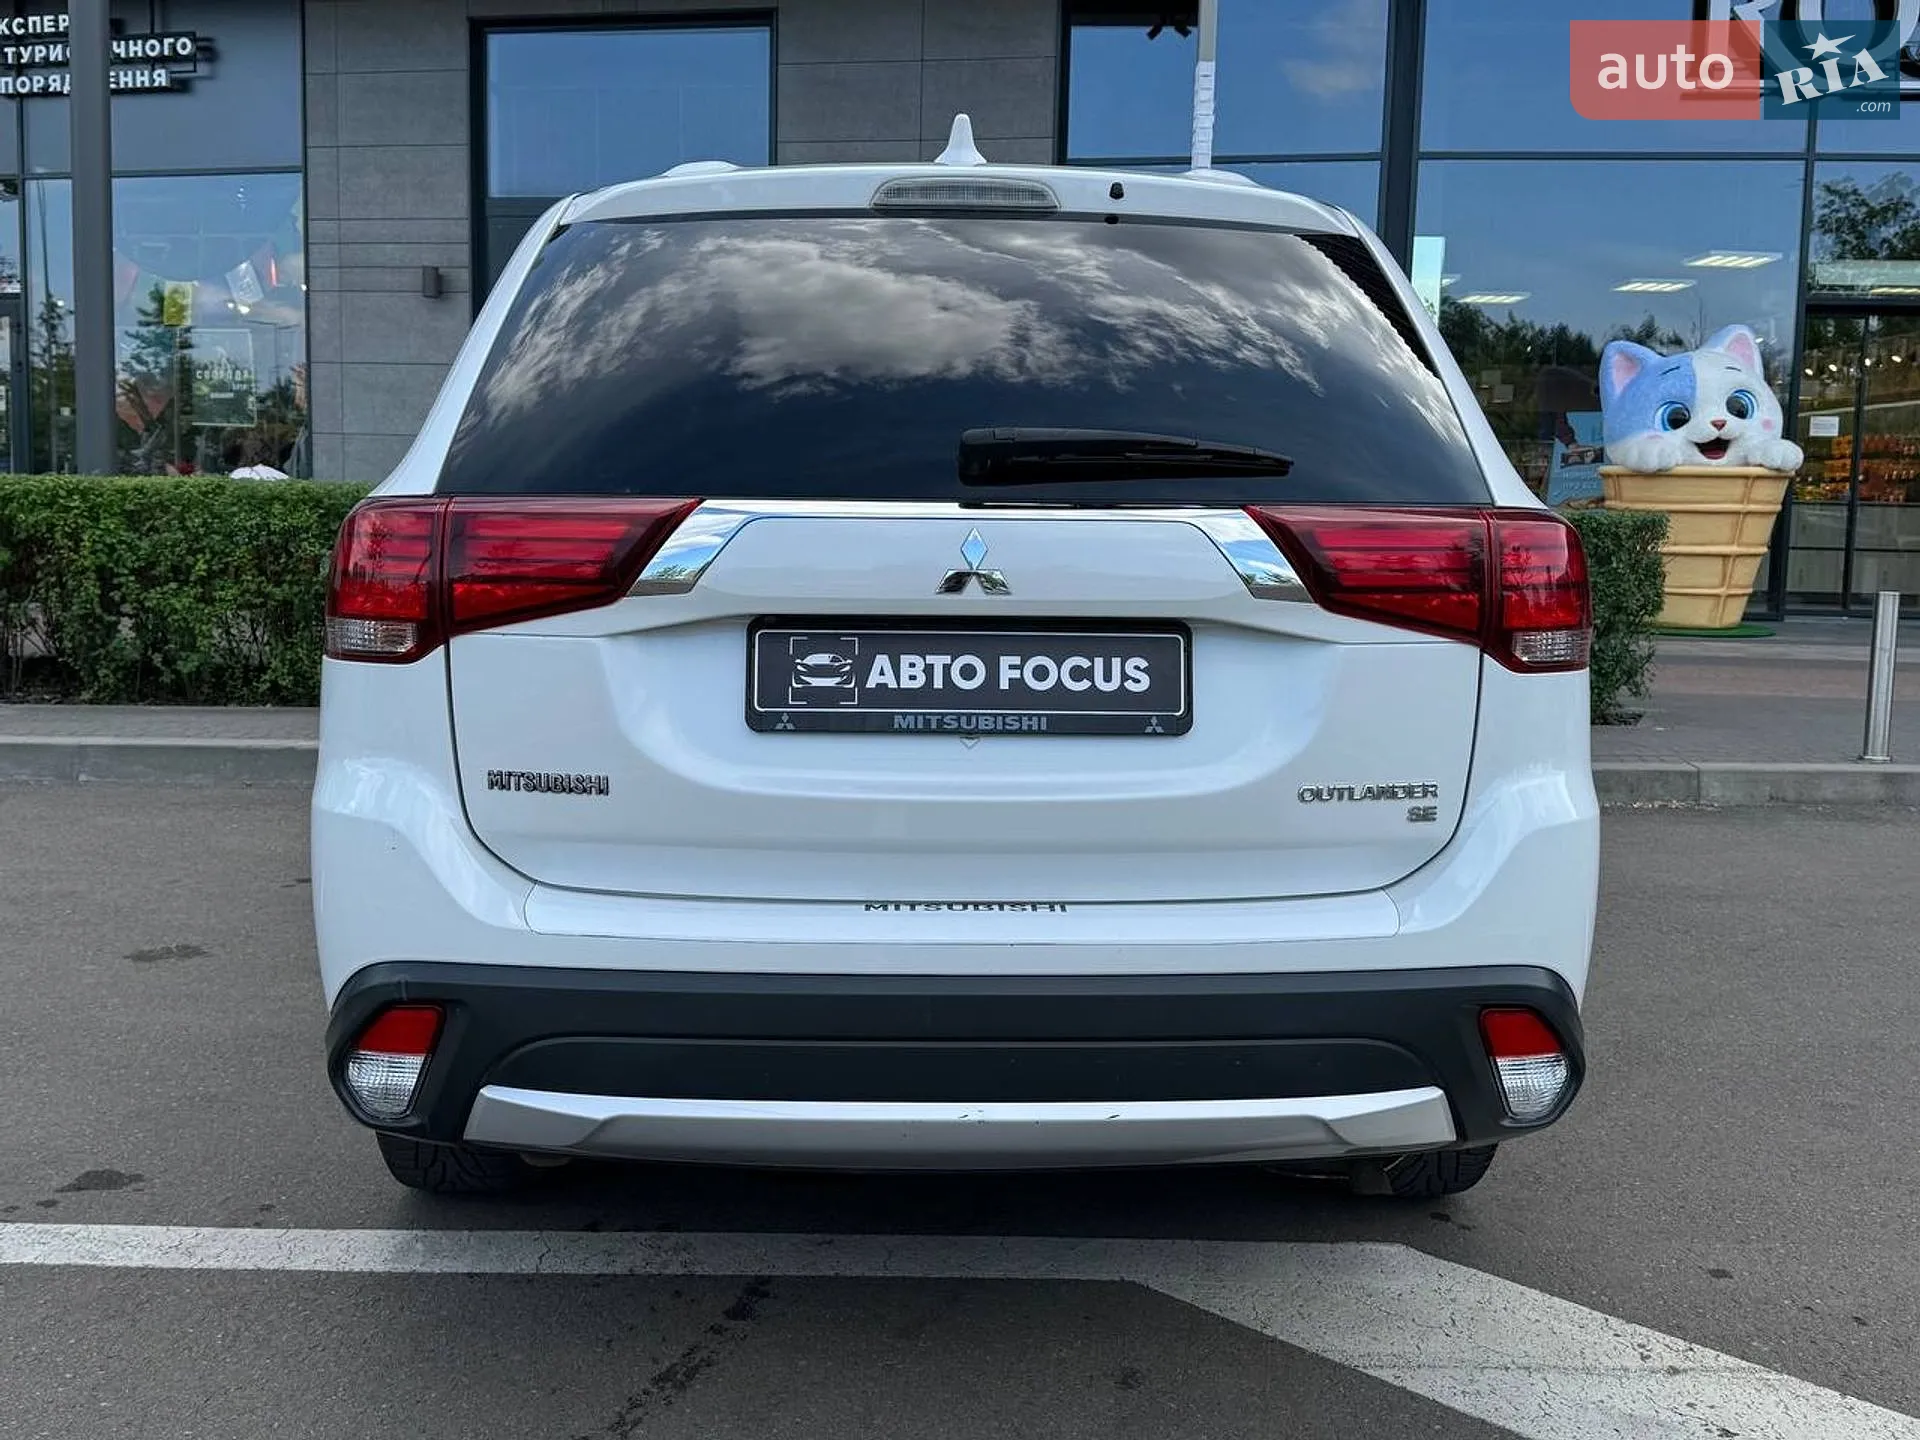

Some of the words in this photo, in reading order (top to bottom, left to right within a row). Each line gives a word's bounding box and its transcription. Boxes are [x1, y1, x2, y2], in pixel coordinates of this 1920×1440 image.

[999, 655, 1151, 692] FOCUS
[893, 715, 1048, 731] MITSUBISHI
[487, 770, 610, 796] MITSUBISHI
[1298, 783, 1439, 802] OUTLANDER
[1407, 805, 1438, 822] SE
[864, 901, 1067, 912] MITSUBISHI
